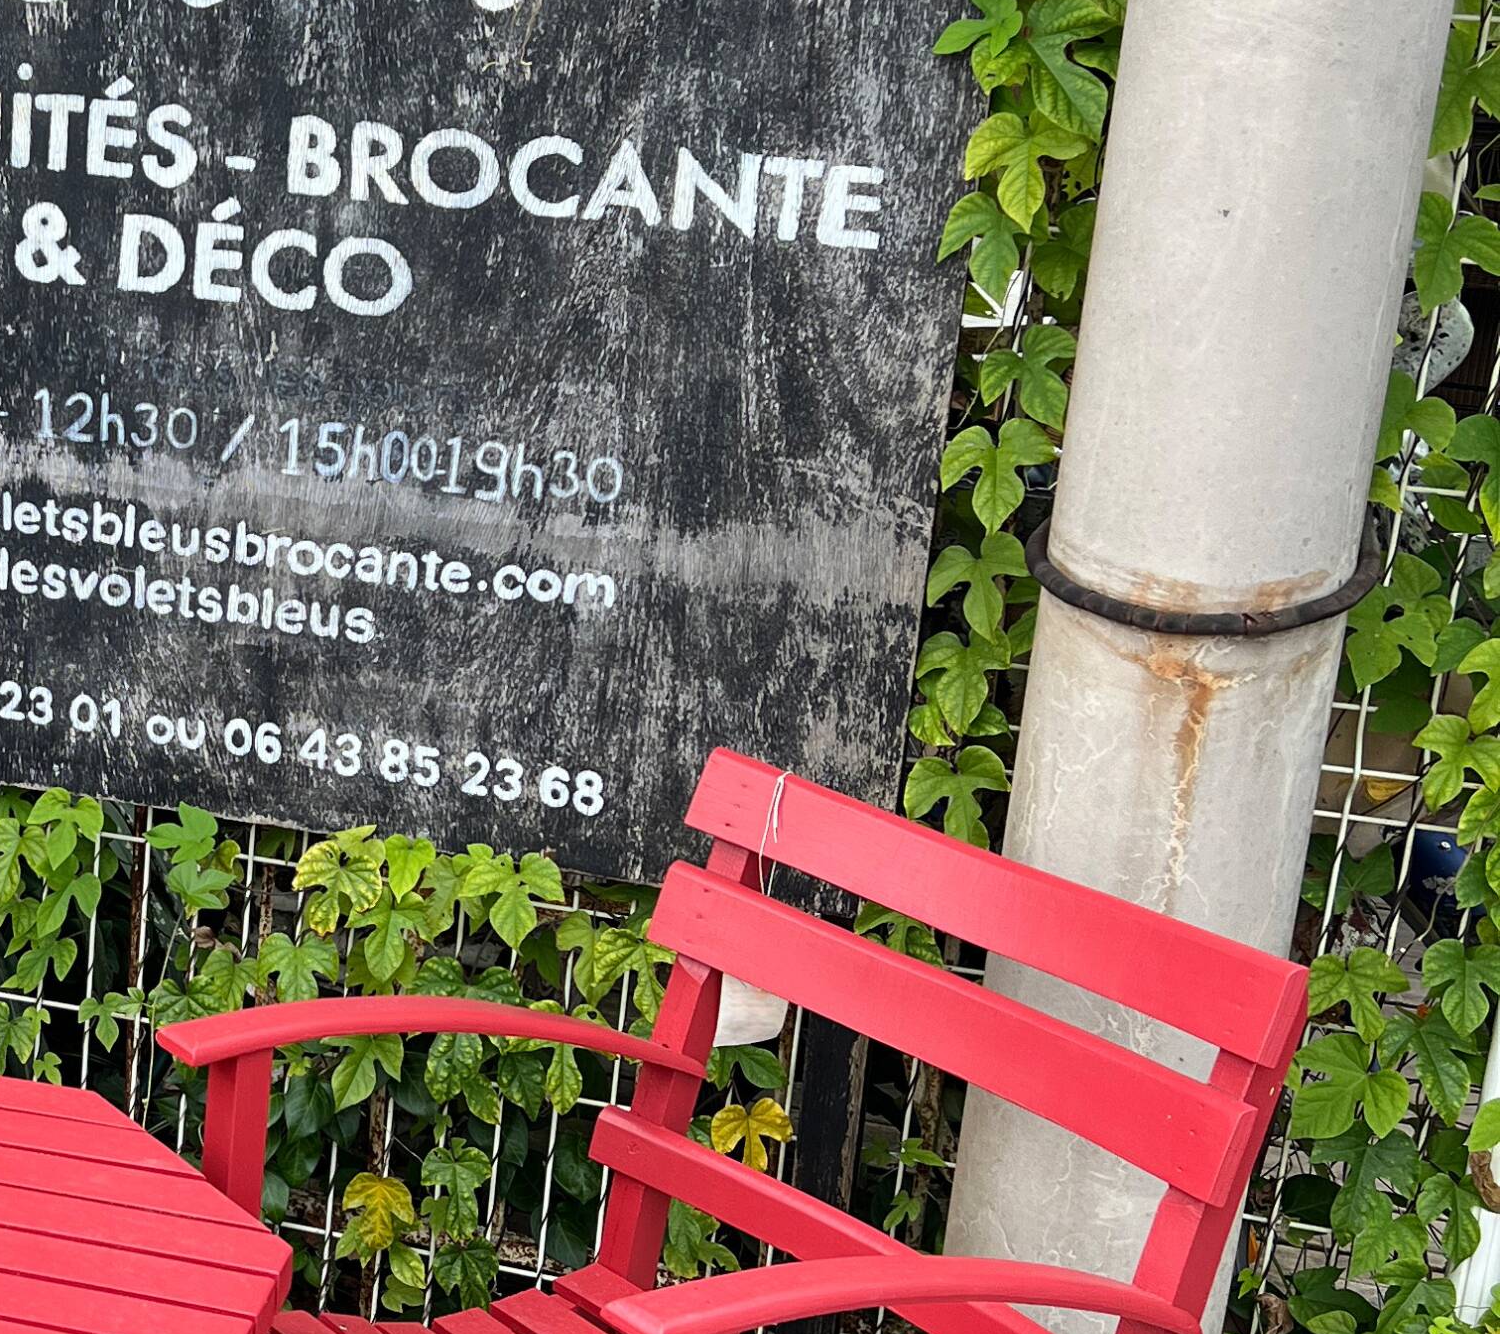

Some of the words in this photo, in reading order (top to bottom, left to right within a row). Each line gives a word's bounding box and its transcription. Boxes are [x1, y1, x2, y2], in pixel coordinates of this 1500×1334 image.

[287, 114, 885, 250] BROCANTE
[14, 201, 87, 285] &
[116, 196, 414, 317] DÉCO
[32, 387, 199, 450] 12h30
[0, 681, 54, 726] 23
[69, 693, 121, 738] 01
[146, 713, 206, 751] ou
[224, 717, 283, 764] 06
[300, 727, 363, 778] 43
[379, 739, 441, 788] 85
[461, 751, 526, 801] 23
[539, 766, 605, 817] 68
